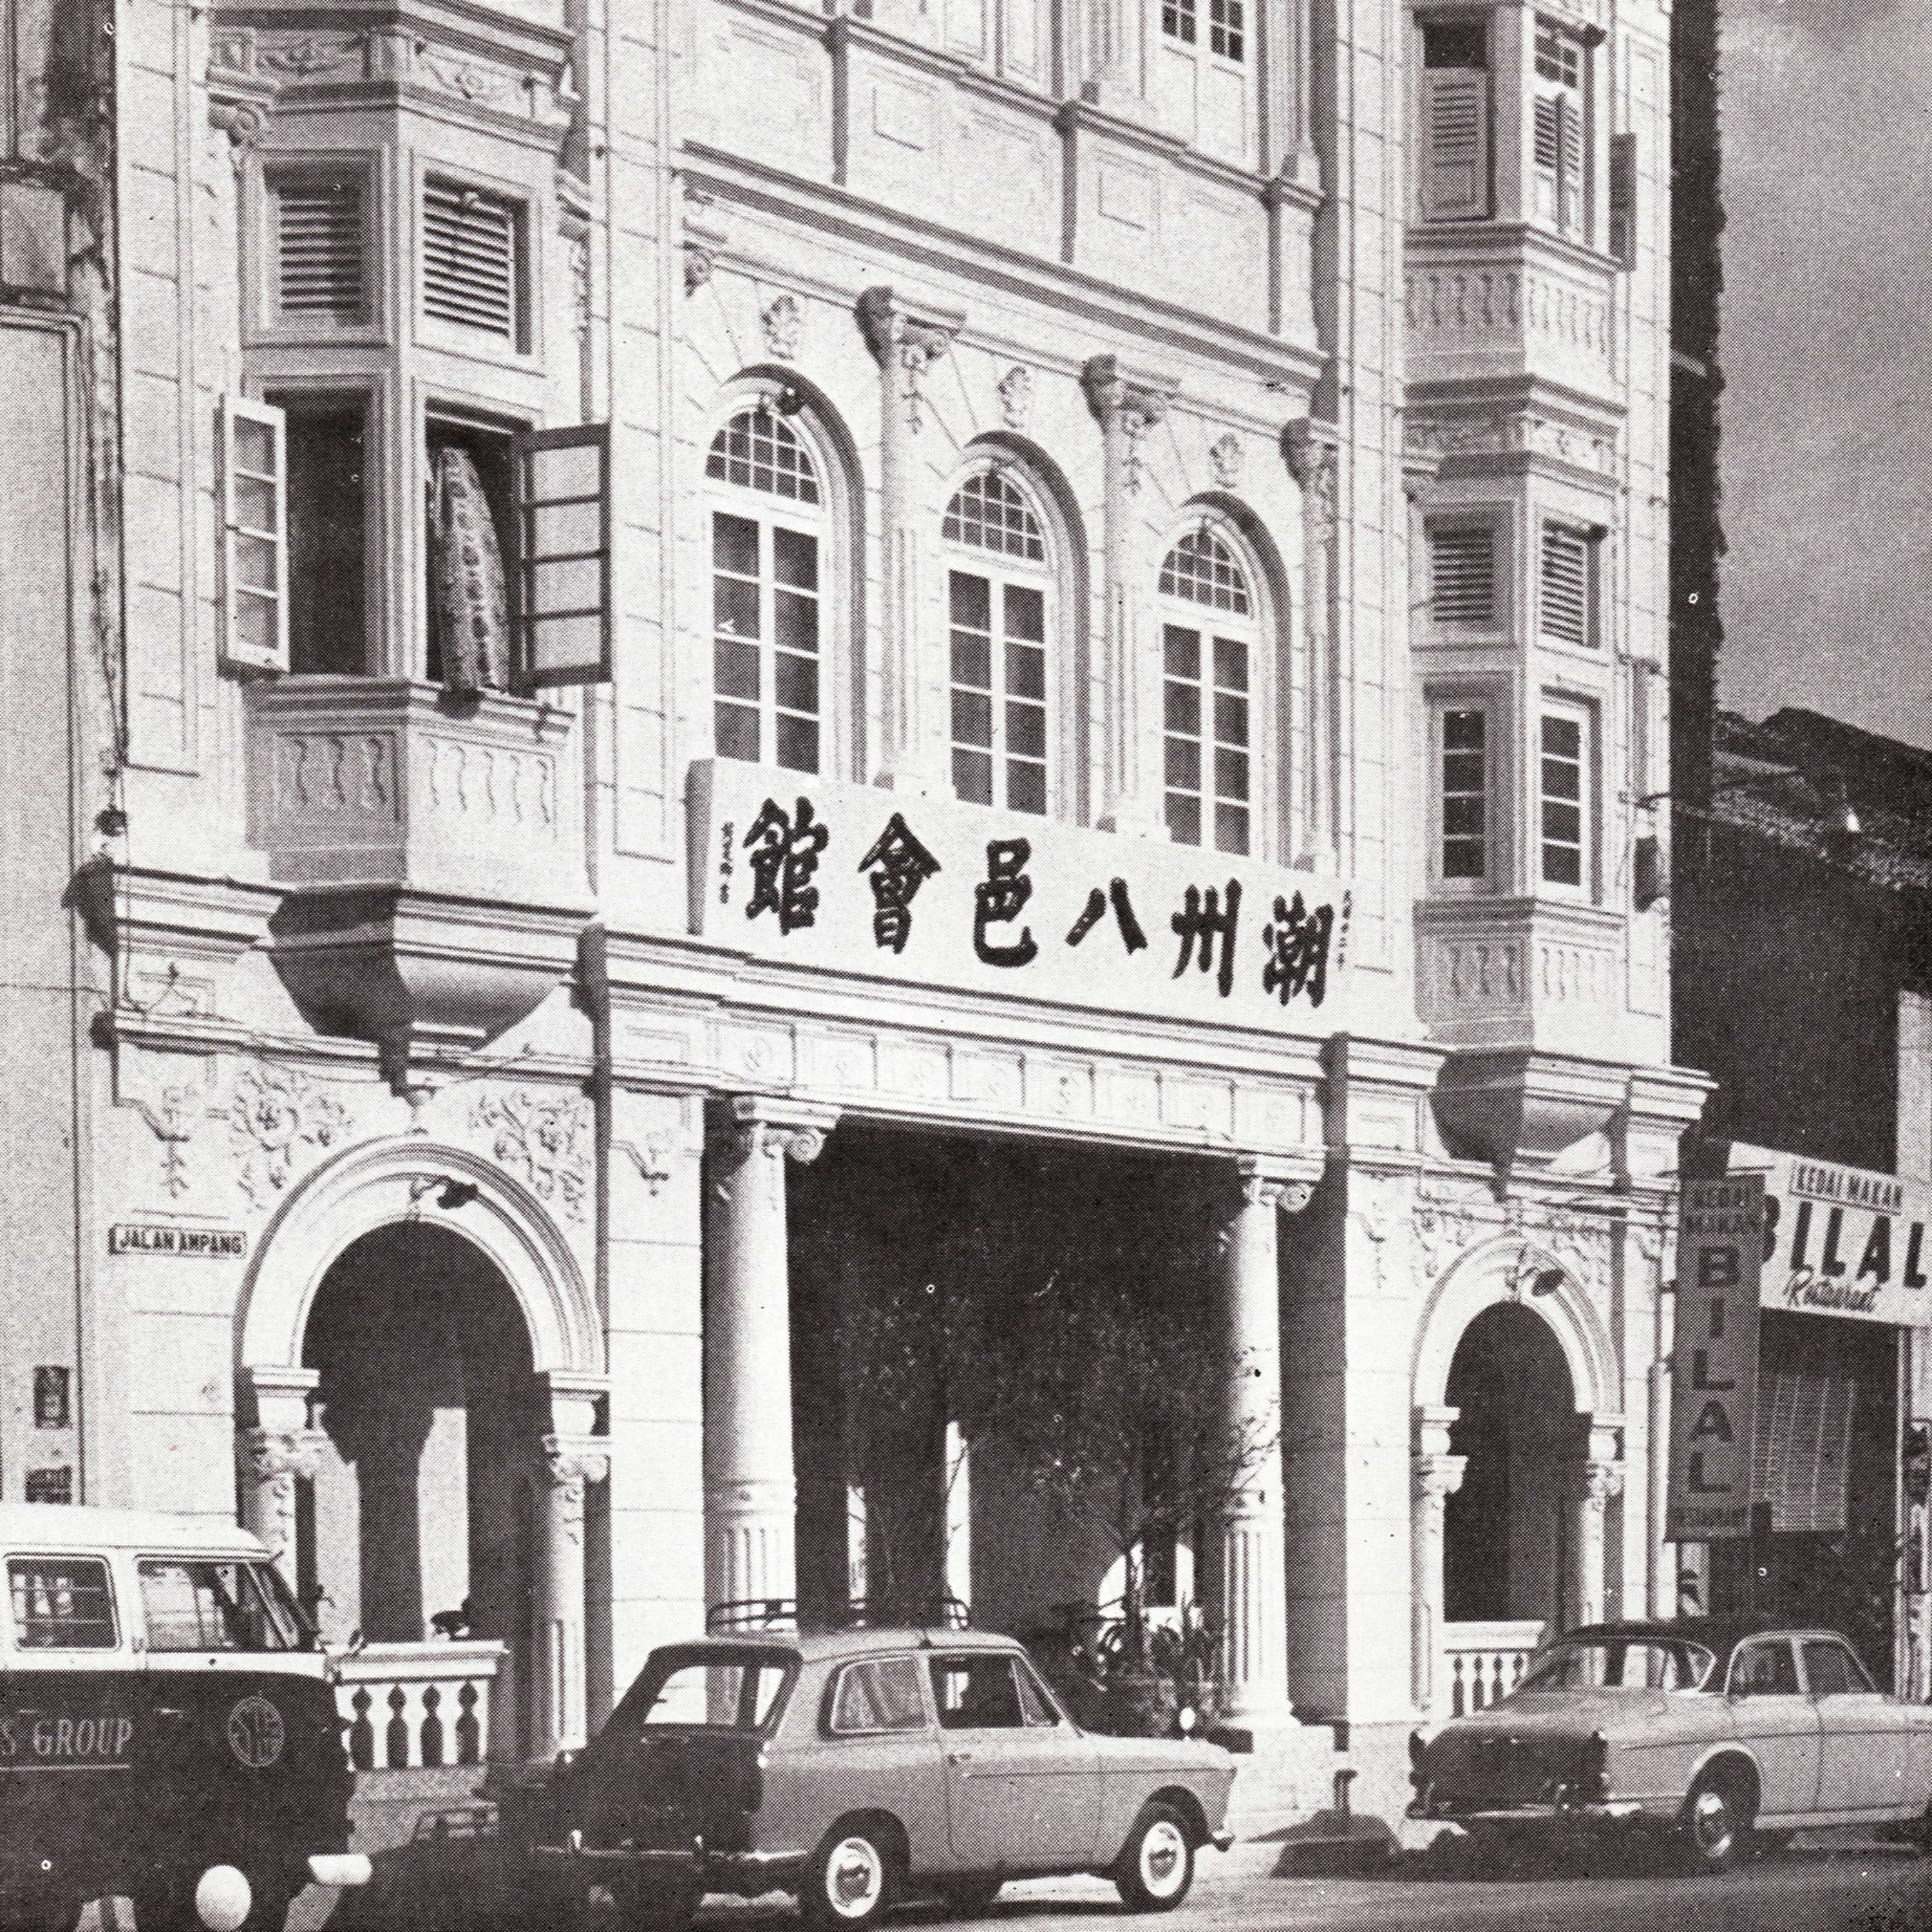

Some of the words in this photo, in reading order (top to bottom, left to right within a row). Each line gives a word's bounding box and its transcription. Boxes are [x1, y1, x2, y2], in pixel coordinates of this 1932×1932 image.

[1797, 1164, 1844, 1197] KEDAI
[1847, 1174, 1904, 1209] MAKAN
[120, 1229, 173, 1250] JALAN
[180, 1233, 241, 1255] AMPANG
[1689, 1247, 1740, 1493] BILAL
[33, 1718, 133, 1757] GROUP
